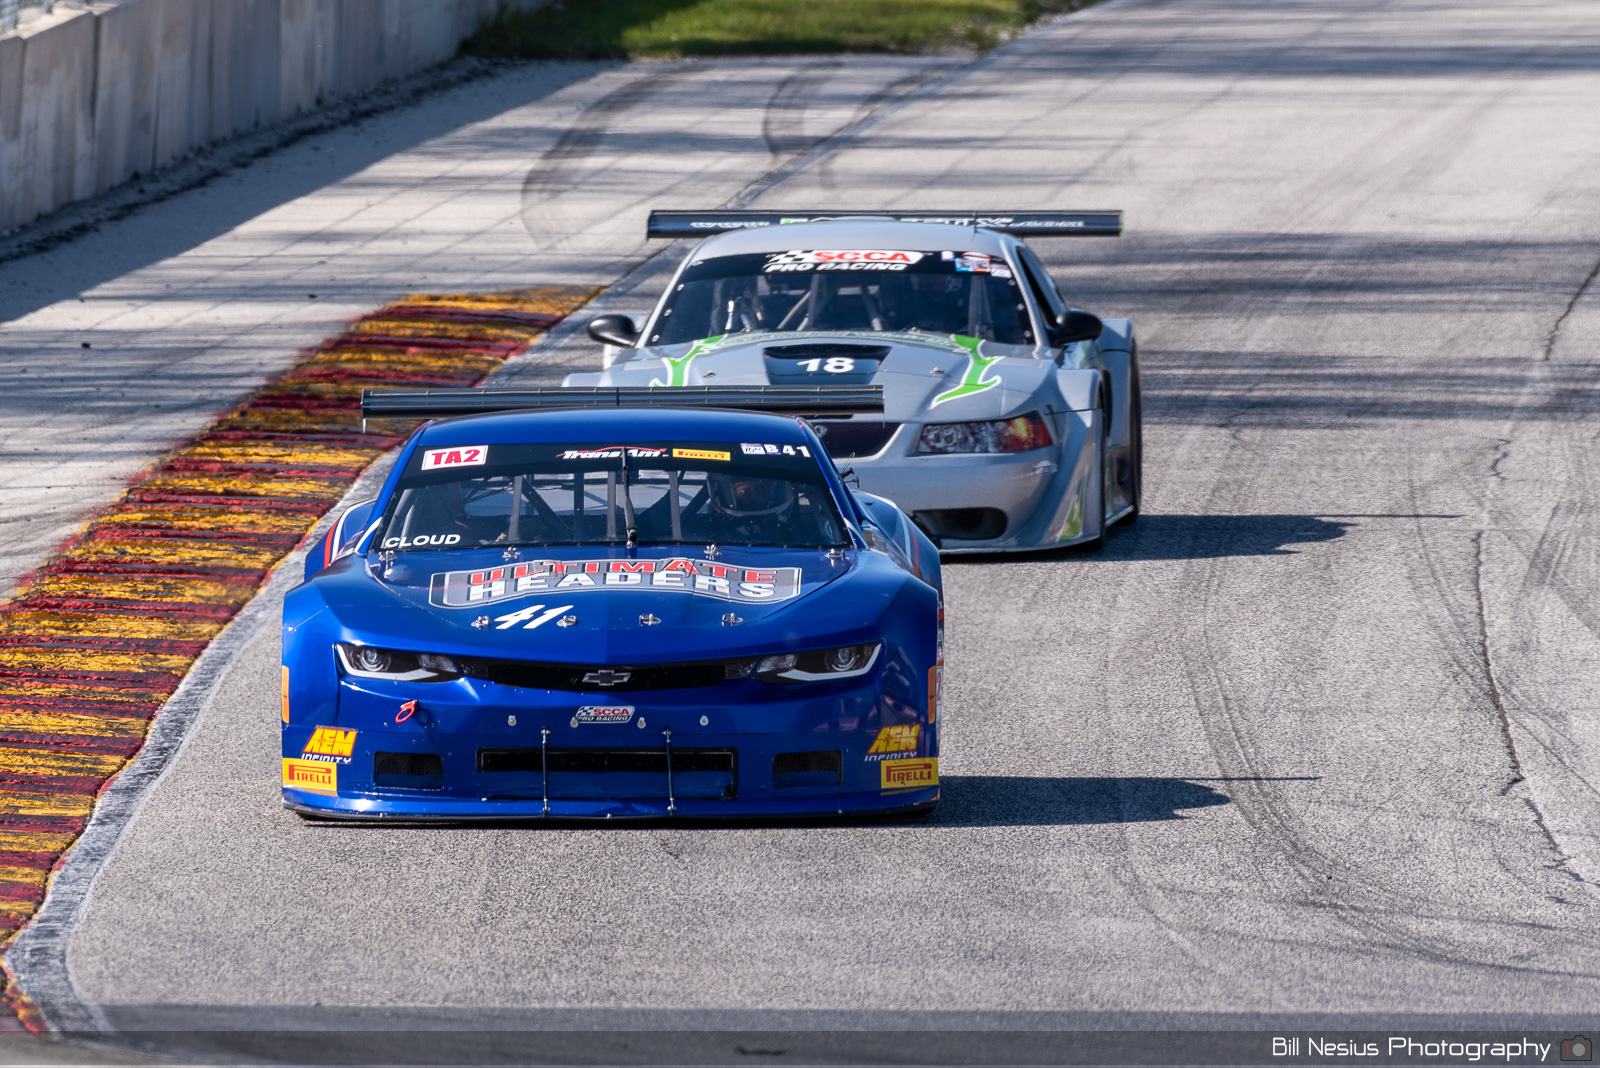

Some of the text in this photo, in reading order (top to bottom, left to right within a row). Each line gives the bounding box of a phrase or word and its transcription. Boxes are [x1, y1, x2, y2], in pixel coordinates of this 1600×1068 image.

[812, 252, 912, 262] SCCA
[763, 263, 908, 273] PRO RACING
[796, 357, 856, 373] 18
[431, 449, 481, 465] TA2
[562, 450, 622, 459] Trans
[782, 444, 811, 458] 41
[385, 534, 461, 548] CLOUD
[470, 559, 777, 585] ULTIMATE
[469, 569, 776, 601] HEADERS
[494, 604, 574, 630] 41
[593, 708, 630, 716] SCCA
[303, 727, 357, 757] AEM
[867, 723, 921, 754] AEM
[864, 752, 917, 762] INFINITY
[288, 764, 332, 785] PIRELLI
[885, 763, 933, 783] PIRELLI
